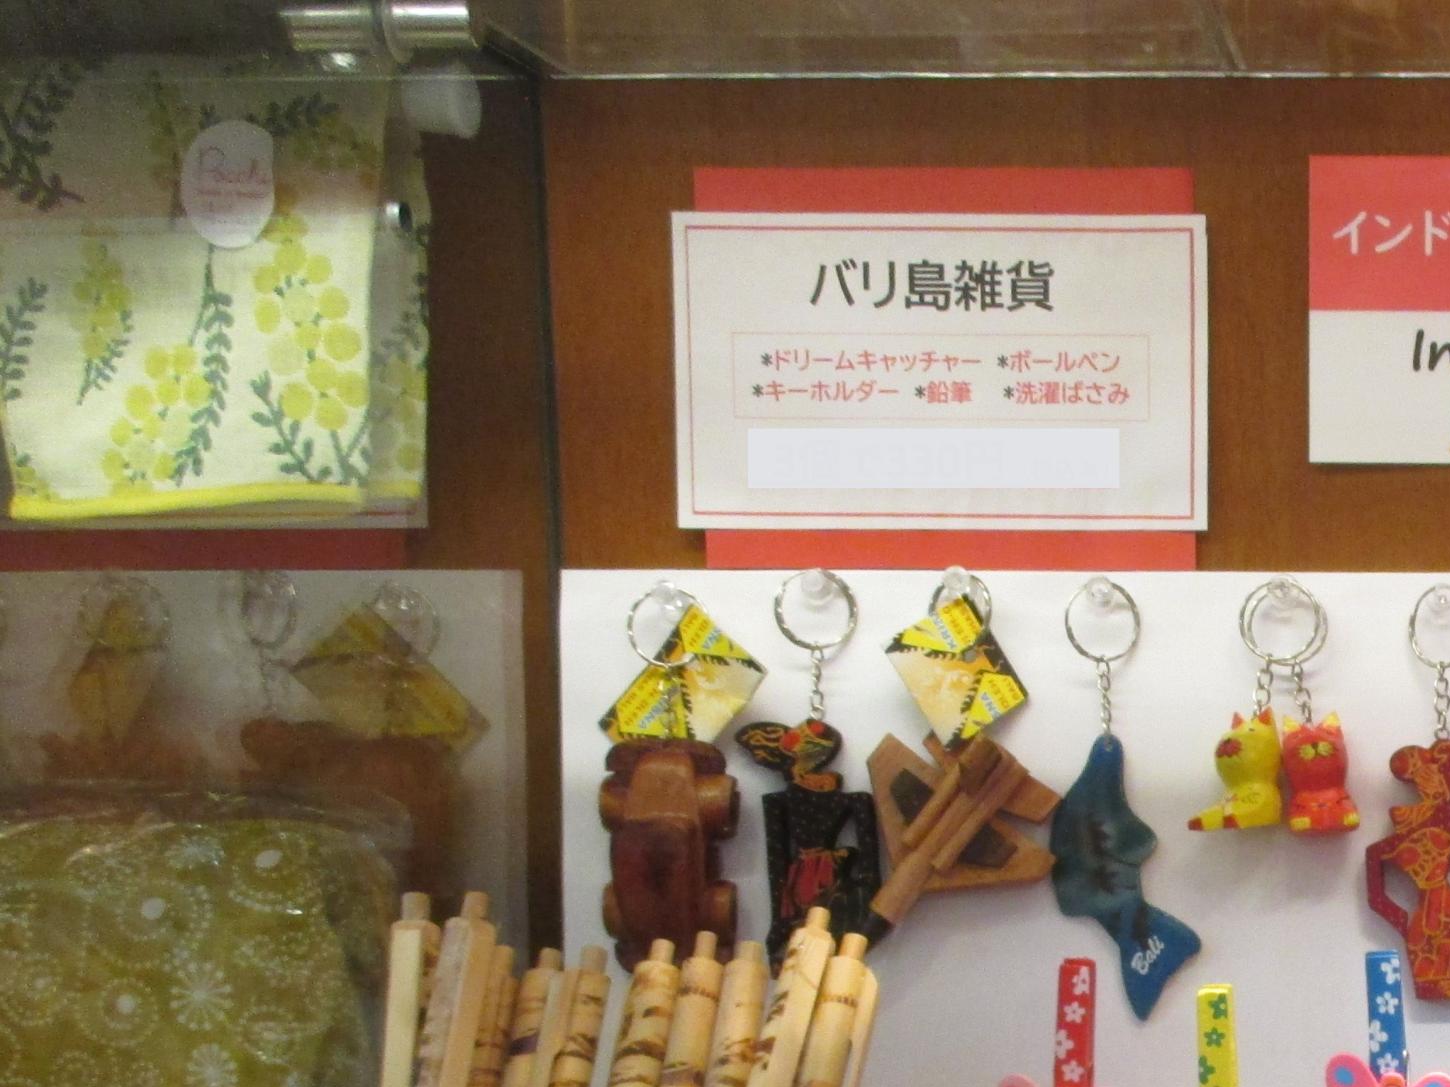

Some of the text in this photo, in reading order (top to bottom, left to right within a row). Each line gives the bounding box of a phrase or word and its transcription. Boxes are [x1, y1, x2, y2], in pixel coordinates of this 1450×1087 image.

[809, 256, 1056, 313] バリ島雑貨
[764, 379, 1130, 406] キーホルダー 鉛筆 洗濯ばさみ
[1130, 935, 1165, 976] Bali
